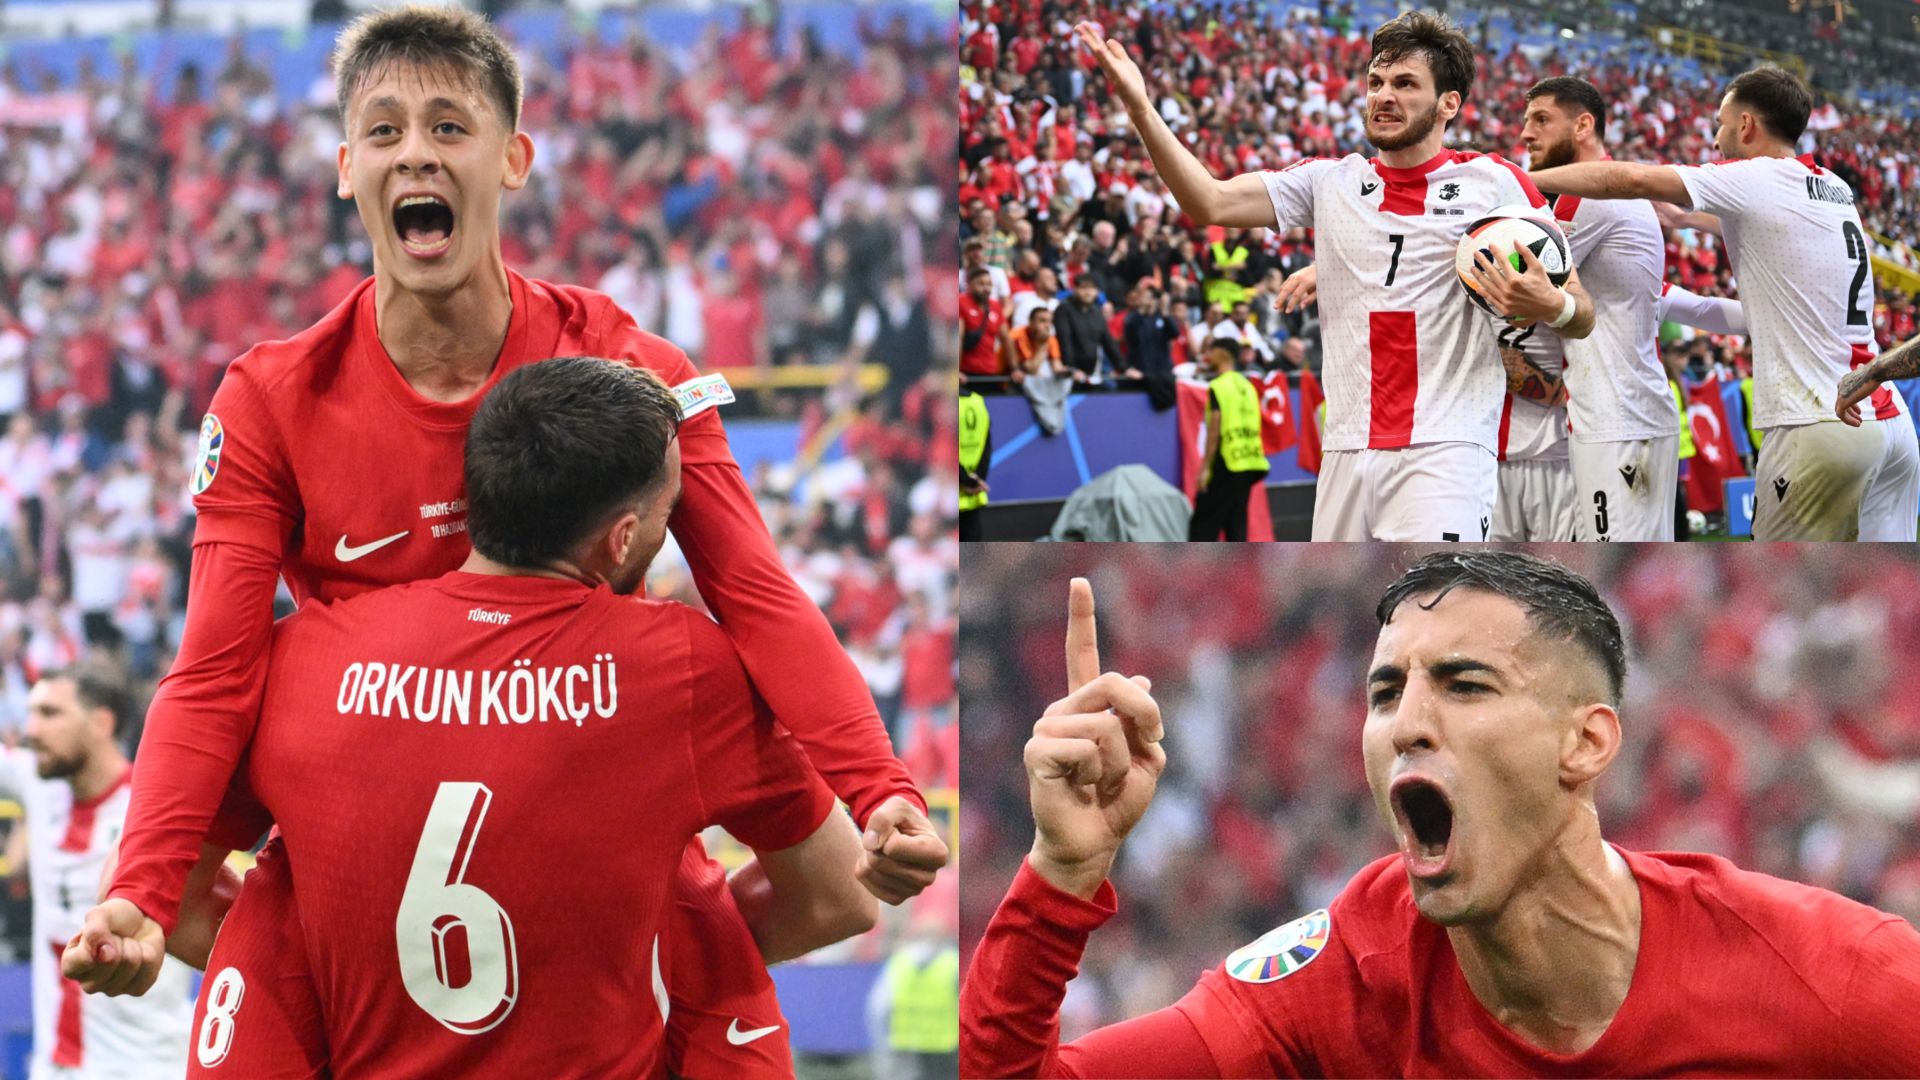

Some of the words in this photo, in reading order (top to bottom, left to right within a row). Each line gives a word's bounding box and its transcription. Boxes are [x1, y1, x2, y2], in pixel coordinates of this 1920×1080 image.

[1385, 234, 1404, 286] 7
[1843, 220, 1868, 325] 2
[1594, 490, 1608, 534] 3
[467, 608, 512, 624] TÜRKİYE
[336, 661, 474, 726] ORKUN
[479, 652, 618, 728] KÖKÇÜ
[396, 782, 518, 1035] 6
[197, 966, 245, 1068] 8
